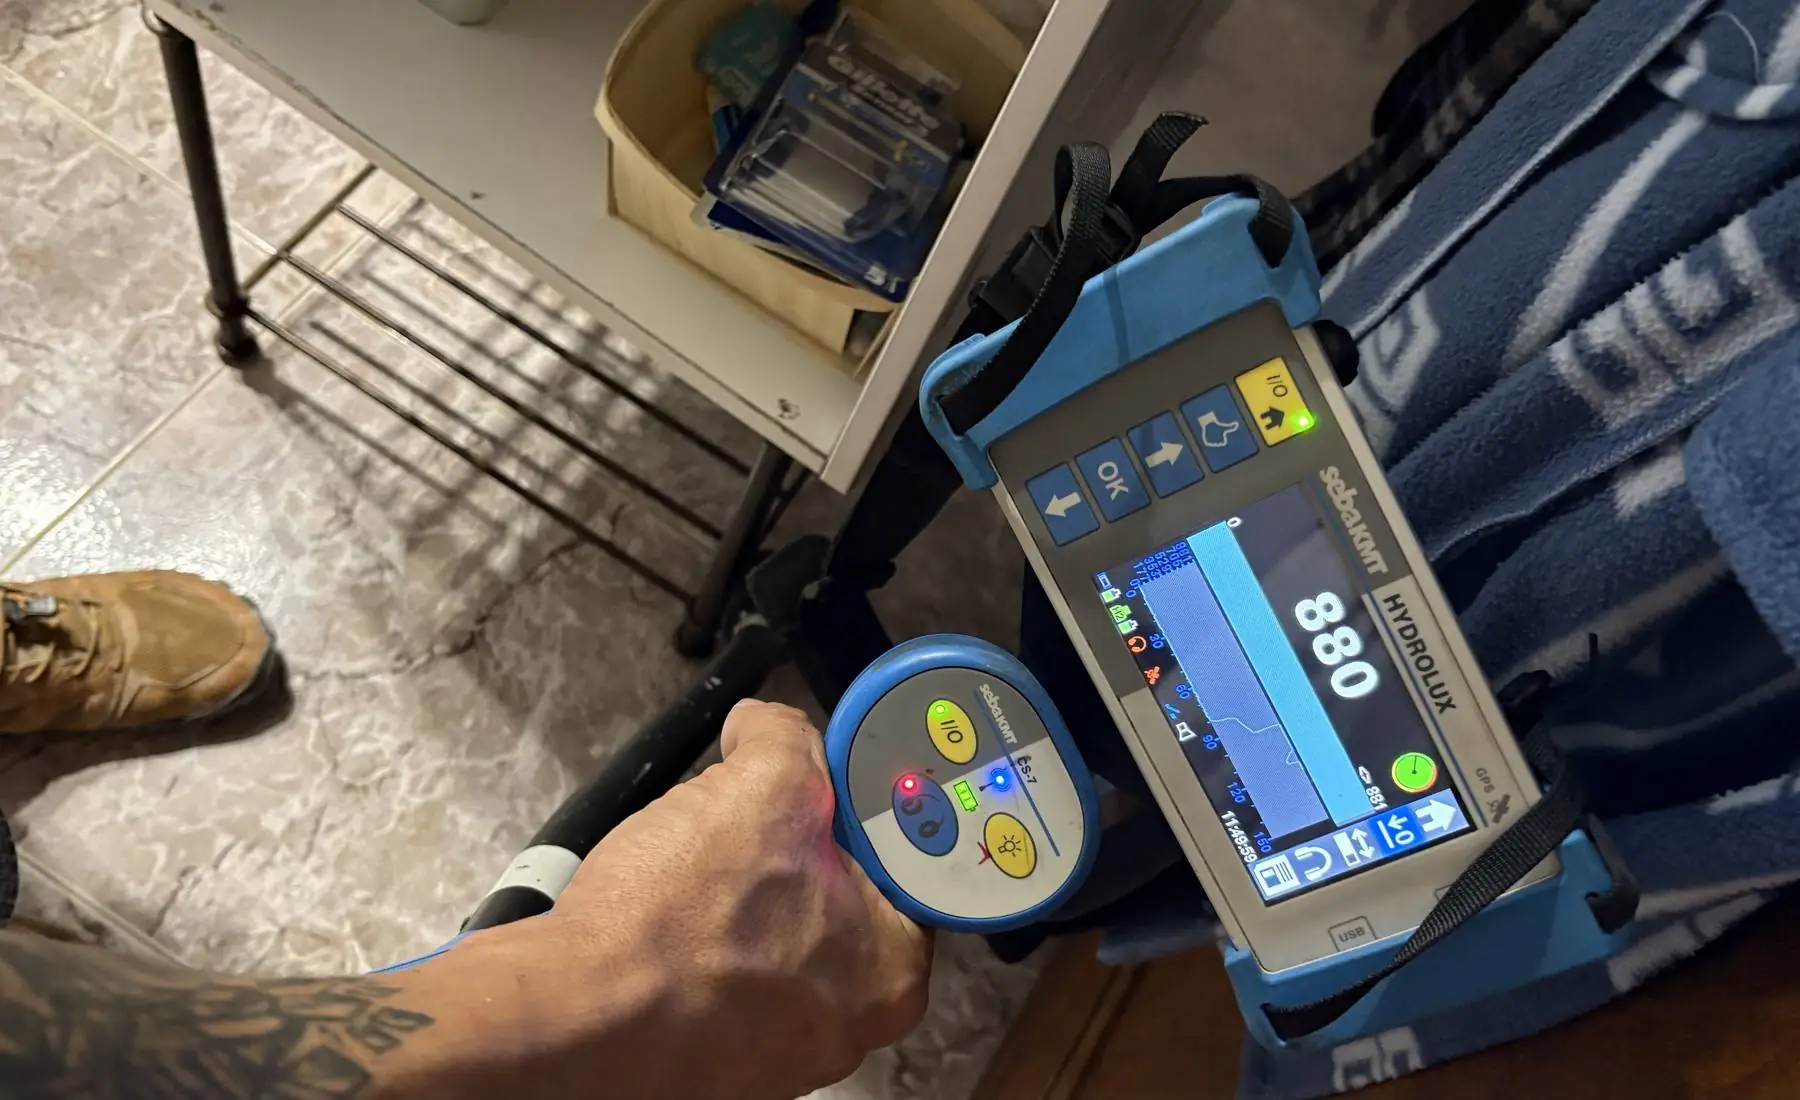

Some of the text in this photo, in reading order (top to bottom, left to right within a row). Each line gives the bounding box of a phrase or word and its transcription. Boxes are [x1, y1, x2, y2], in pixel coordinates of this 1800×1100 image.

[1266, 374, 1288, 398] I/O
[1097, 461, 1129, 500] OK
[1226, 516, 1243, 528] 0
[1319, 465, 1389, 576] sebaKMT
[1149, 633, 1164, 649] 30
[1295, 591, 1379, 699] 880
[1383, 593, 1457, 715] HYDROLUX
[1175, 683, 1191, 700] 60
[979, 683, 1018, 745] sebaKMT
[1202, 734, 1218, 750] 90
[1017, 756, 1038, 784] CS-7
[1474, 767, 1497, 794] GPS
[1227, 781, 1246, 804] 120
[1365, 786, 1388, 812] 881
[1220, 810, 1258, 864] 11:49:59
[1253, 831, 1272, 853] 150
[1337, 926, 1366, 945] USB
